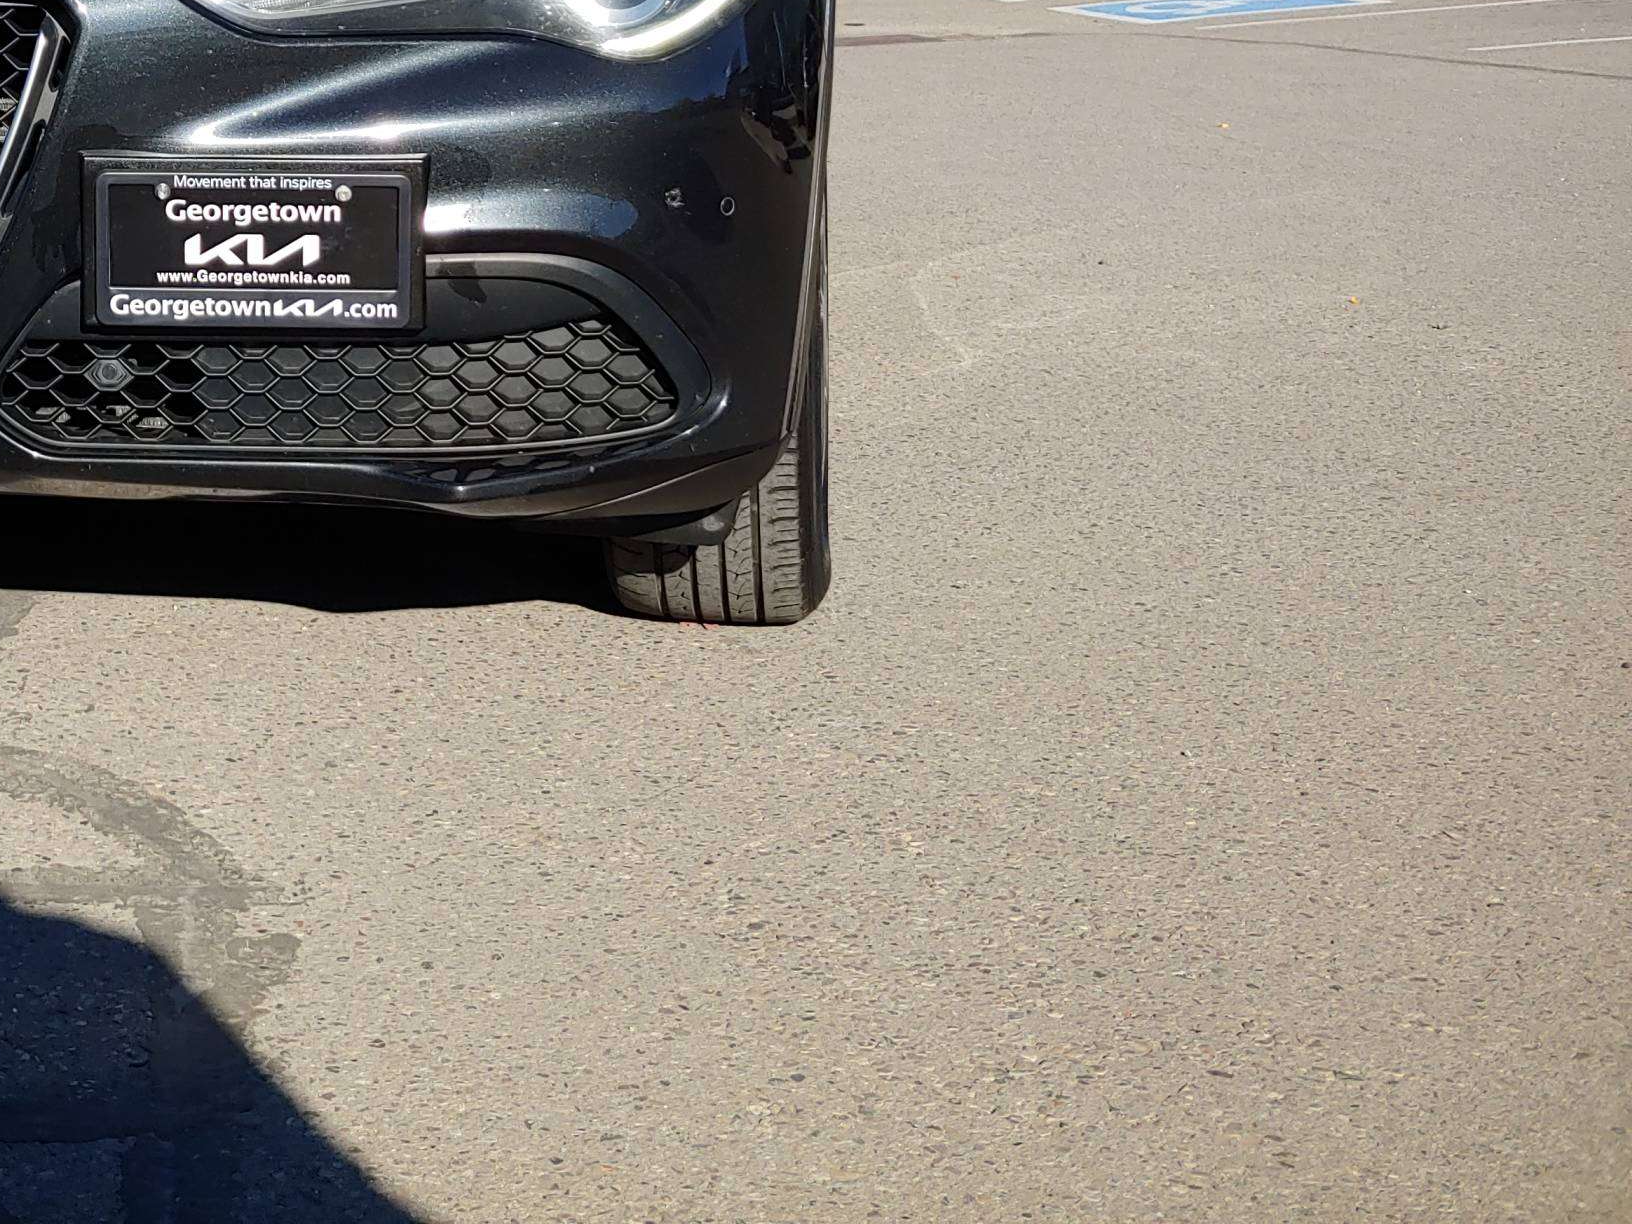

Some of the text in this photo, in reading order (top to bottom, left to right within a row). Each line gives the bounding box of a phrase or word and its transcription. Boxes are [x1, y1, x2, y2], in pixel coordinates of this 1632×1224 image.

[174, 175, 332, 191] Movement that inspires
[165, 199, 341, 226] Georgetown
[184, 233, 320, 266] KIA
[157, 269, 350, 285] www.Georgetownkia.com
